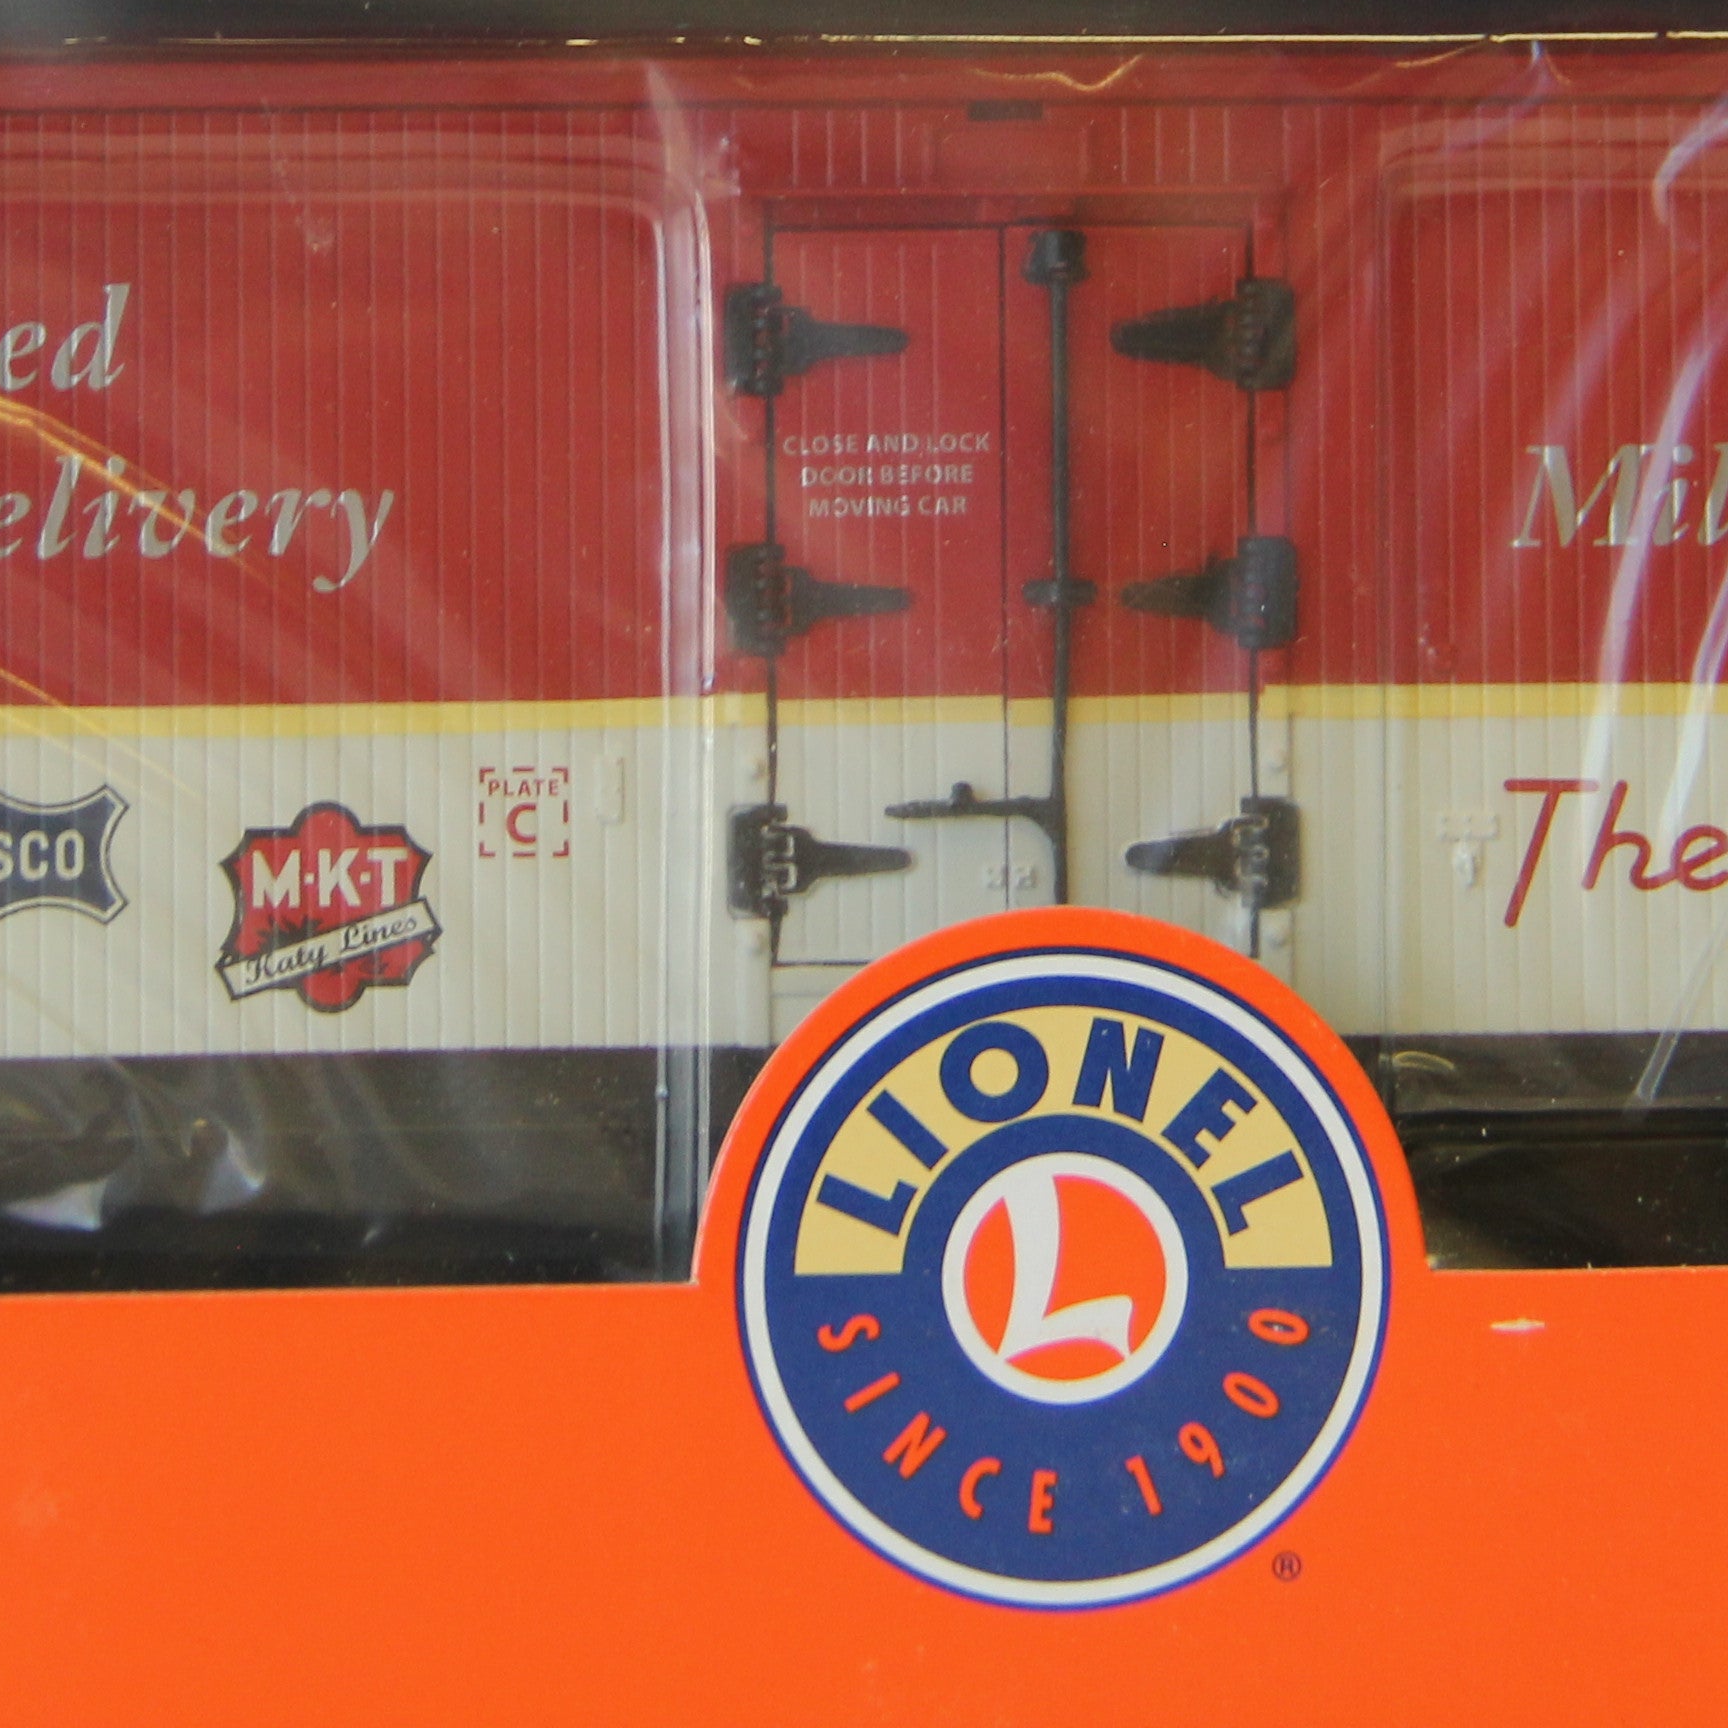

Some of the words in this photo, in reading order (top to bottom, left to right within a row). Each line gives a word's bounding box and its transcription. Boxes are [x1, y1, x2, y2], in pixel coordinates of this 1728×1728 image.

[783, 434, 859, 456] CLOSE
[867, 433, 920, 454] AND
[927, 431, 991, 453] LOCK
[802, 465, 874, 487] DOOR
[880, 463, 974, 485] BEFORE
[809, 494, 910, 518] MOVING
[918, 494, 968, 515] CAR
[487, 779, 561, 797] PLATE
[505, 803, 538, 844] C
[244, 945, 326, 984] Katy
[339, 913, 419, 953] Lines
[816, 1018, 1304, 1236] LIONEL
[817, 1315, 1056, 1532] SINCE
[1126, 1308, 1309, 1514] 1900
